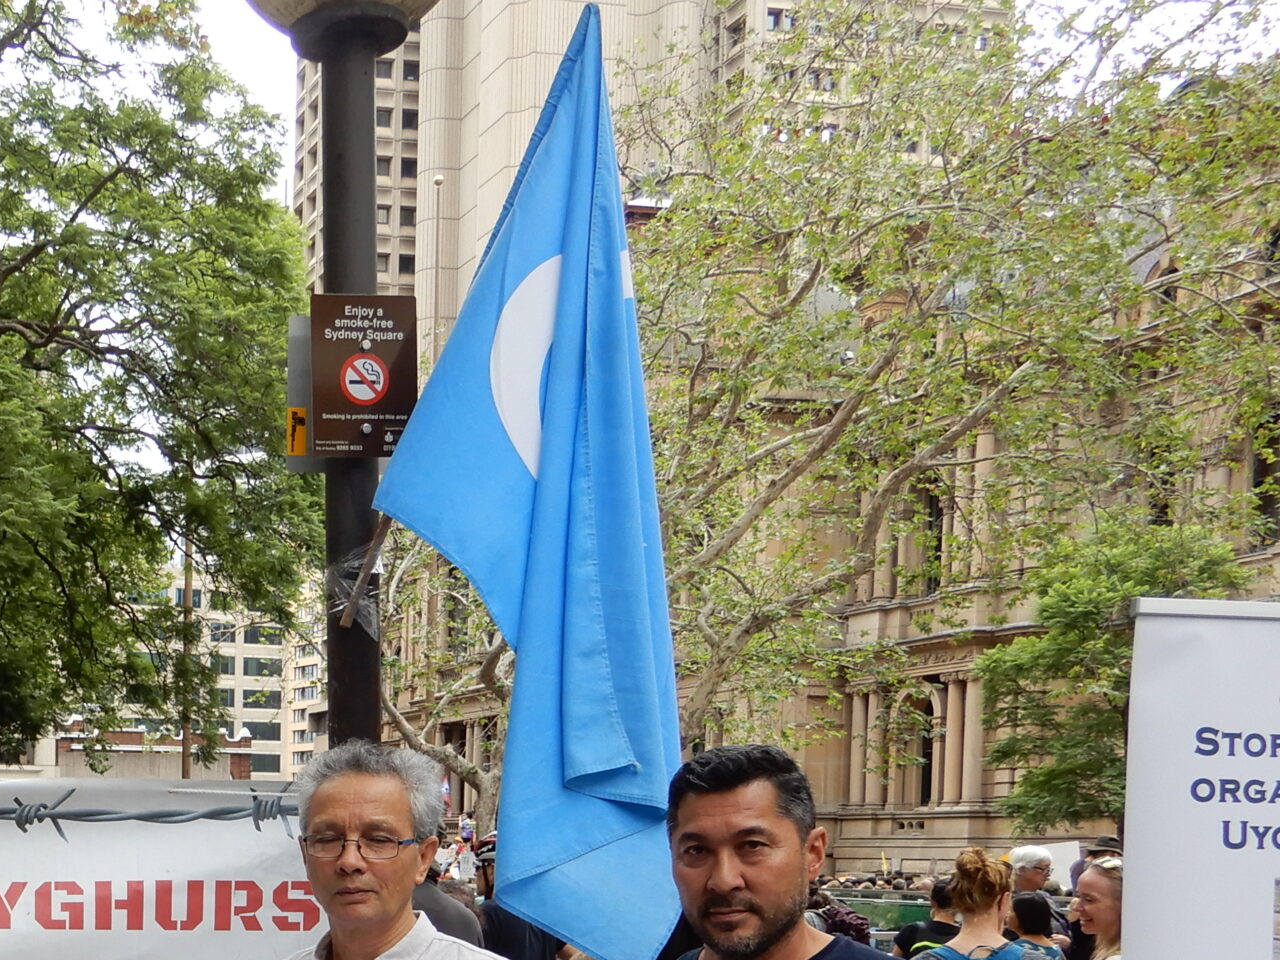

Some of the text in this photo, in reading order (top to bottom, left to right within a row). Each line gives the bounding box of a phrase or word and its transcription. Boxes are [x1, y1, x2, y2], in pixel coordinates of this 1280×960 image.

[344, 305, 384, 321] Enjoy a
[334, 317, 394, 328] smoke-free
[324, 328, 404, 341] Sydney Square
